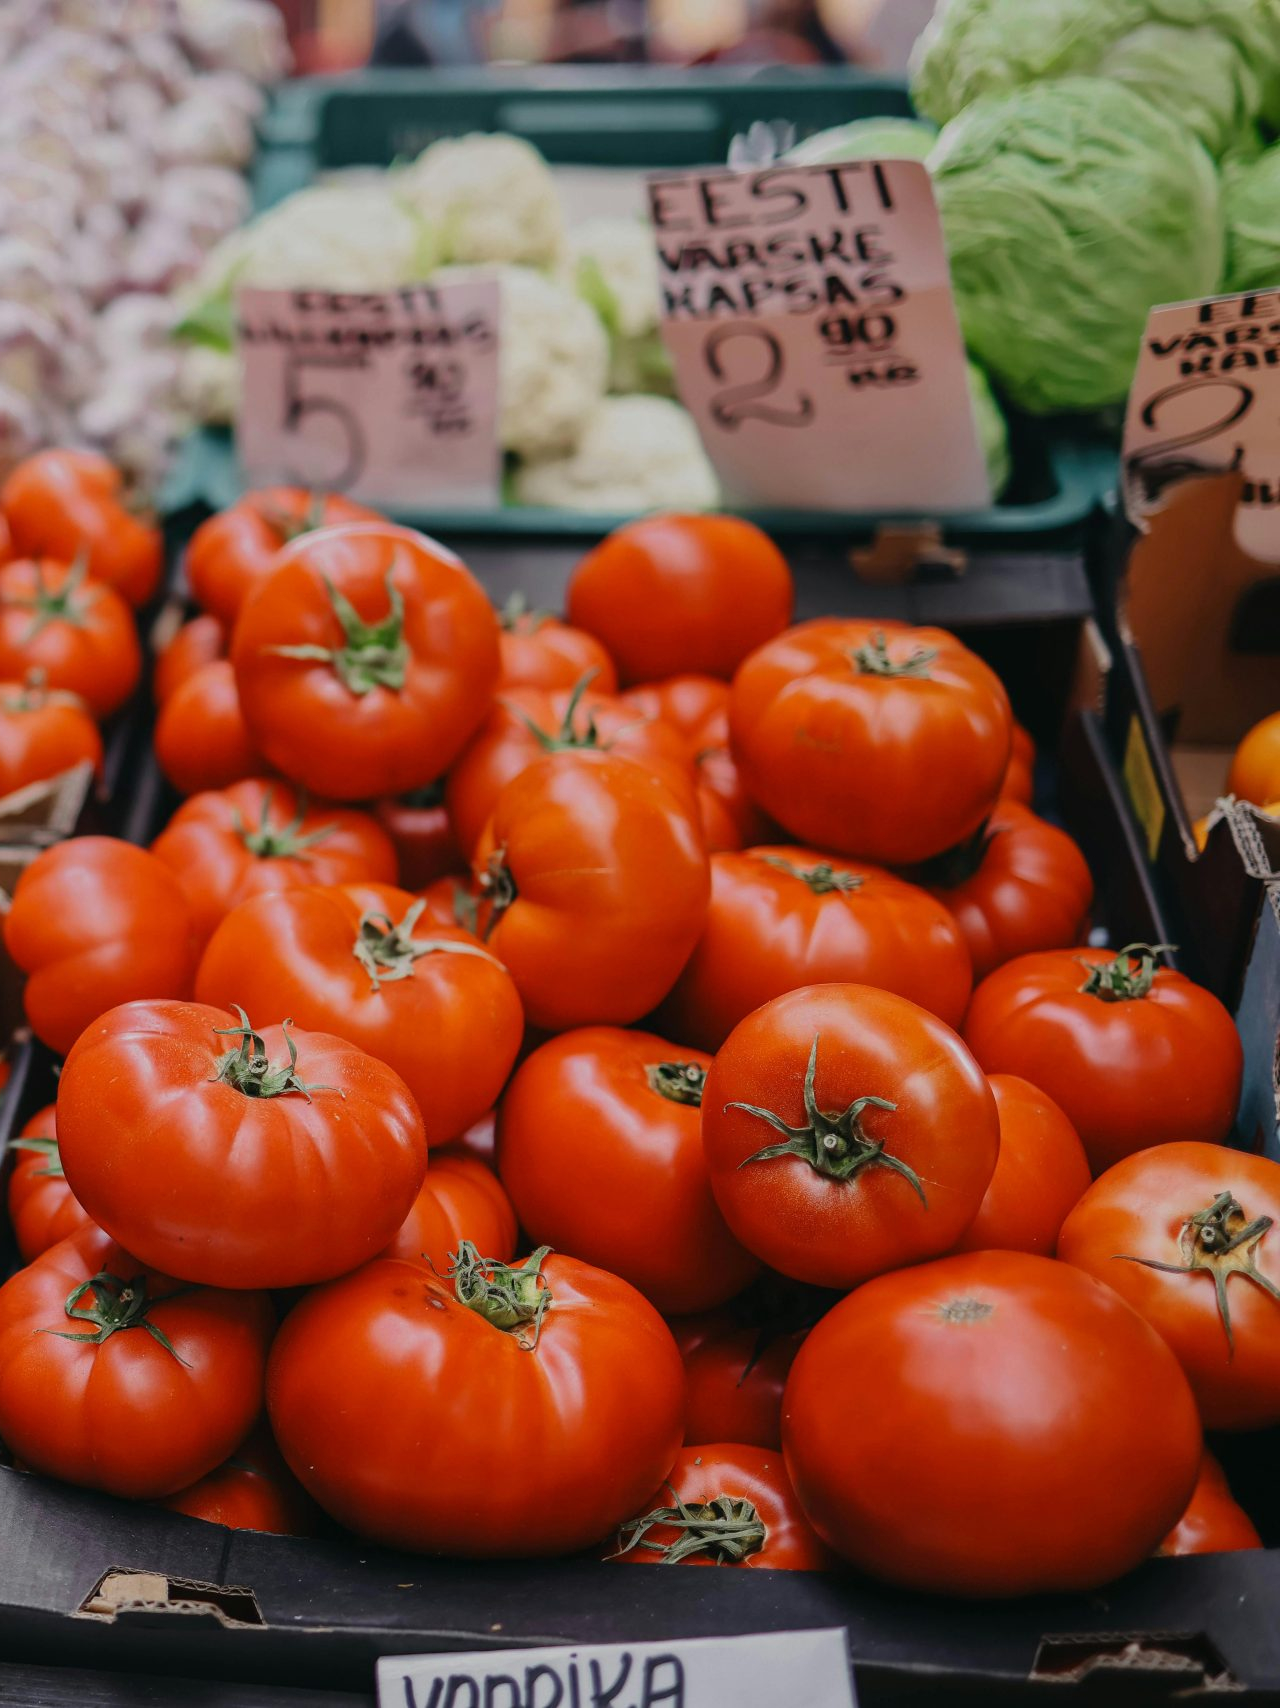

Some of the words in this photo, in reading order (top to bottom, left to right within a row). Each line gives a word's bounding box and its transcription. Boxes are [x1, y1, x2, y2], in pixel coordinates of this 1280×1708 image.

[646, 164, 893, 230] EESTI
[663, 271, 905, 316] KAPSAS
[703, 320, 814, 432] 2
[282, 354, 370, 494] 5
